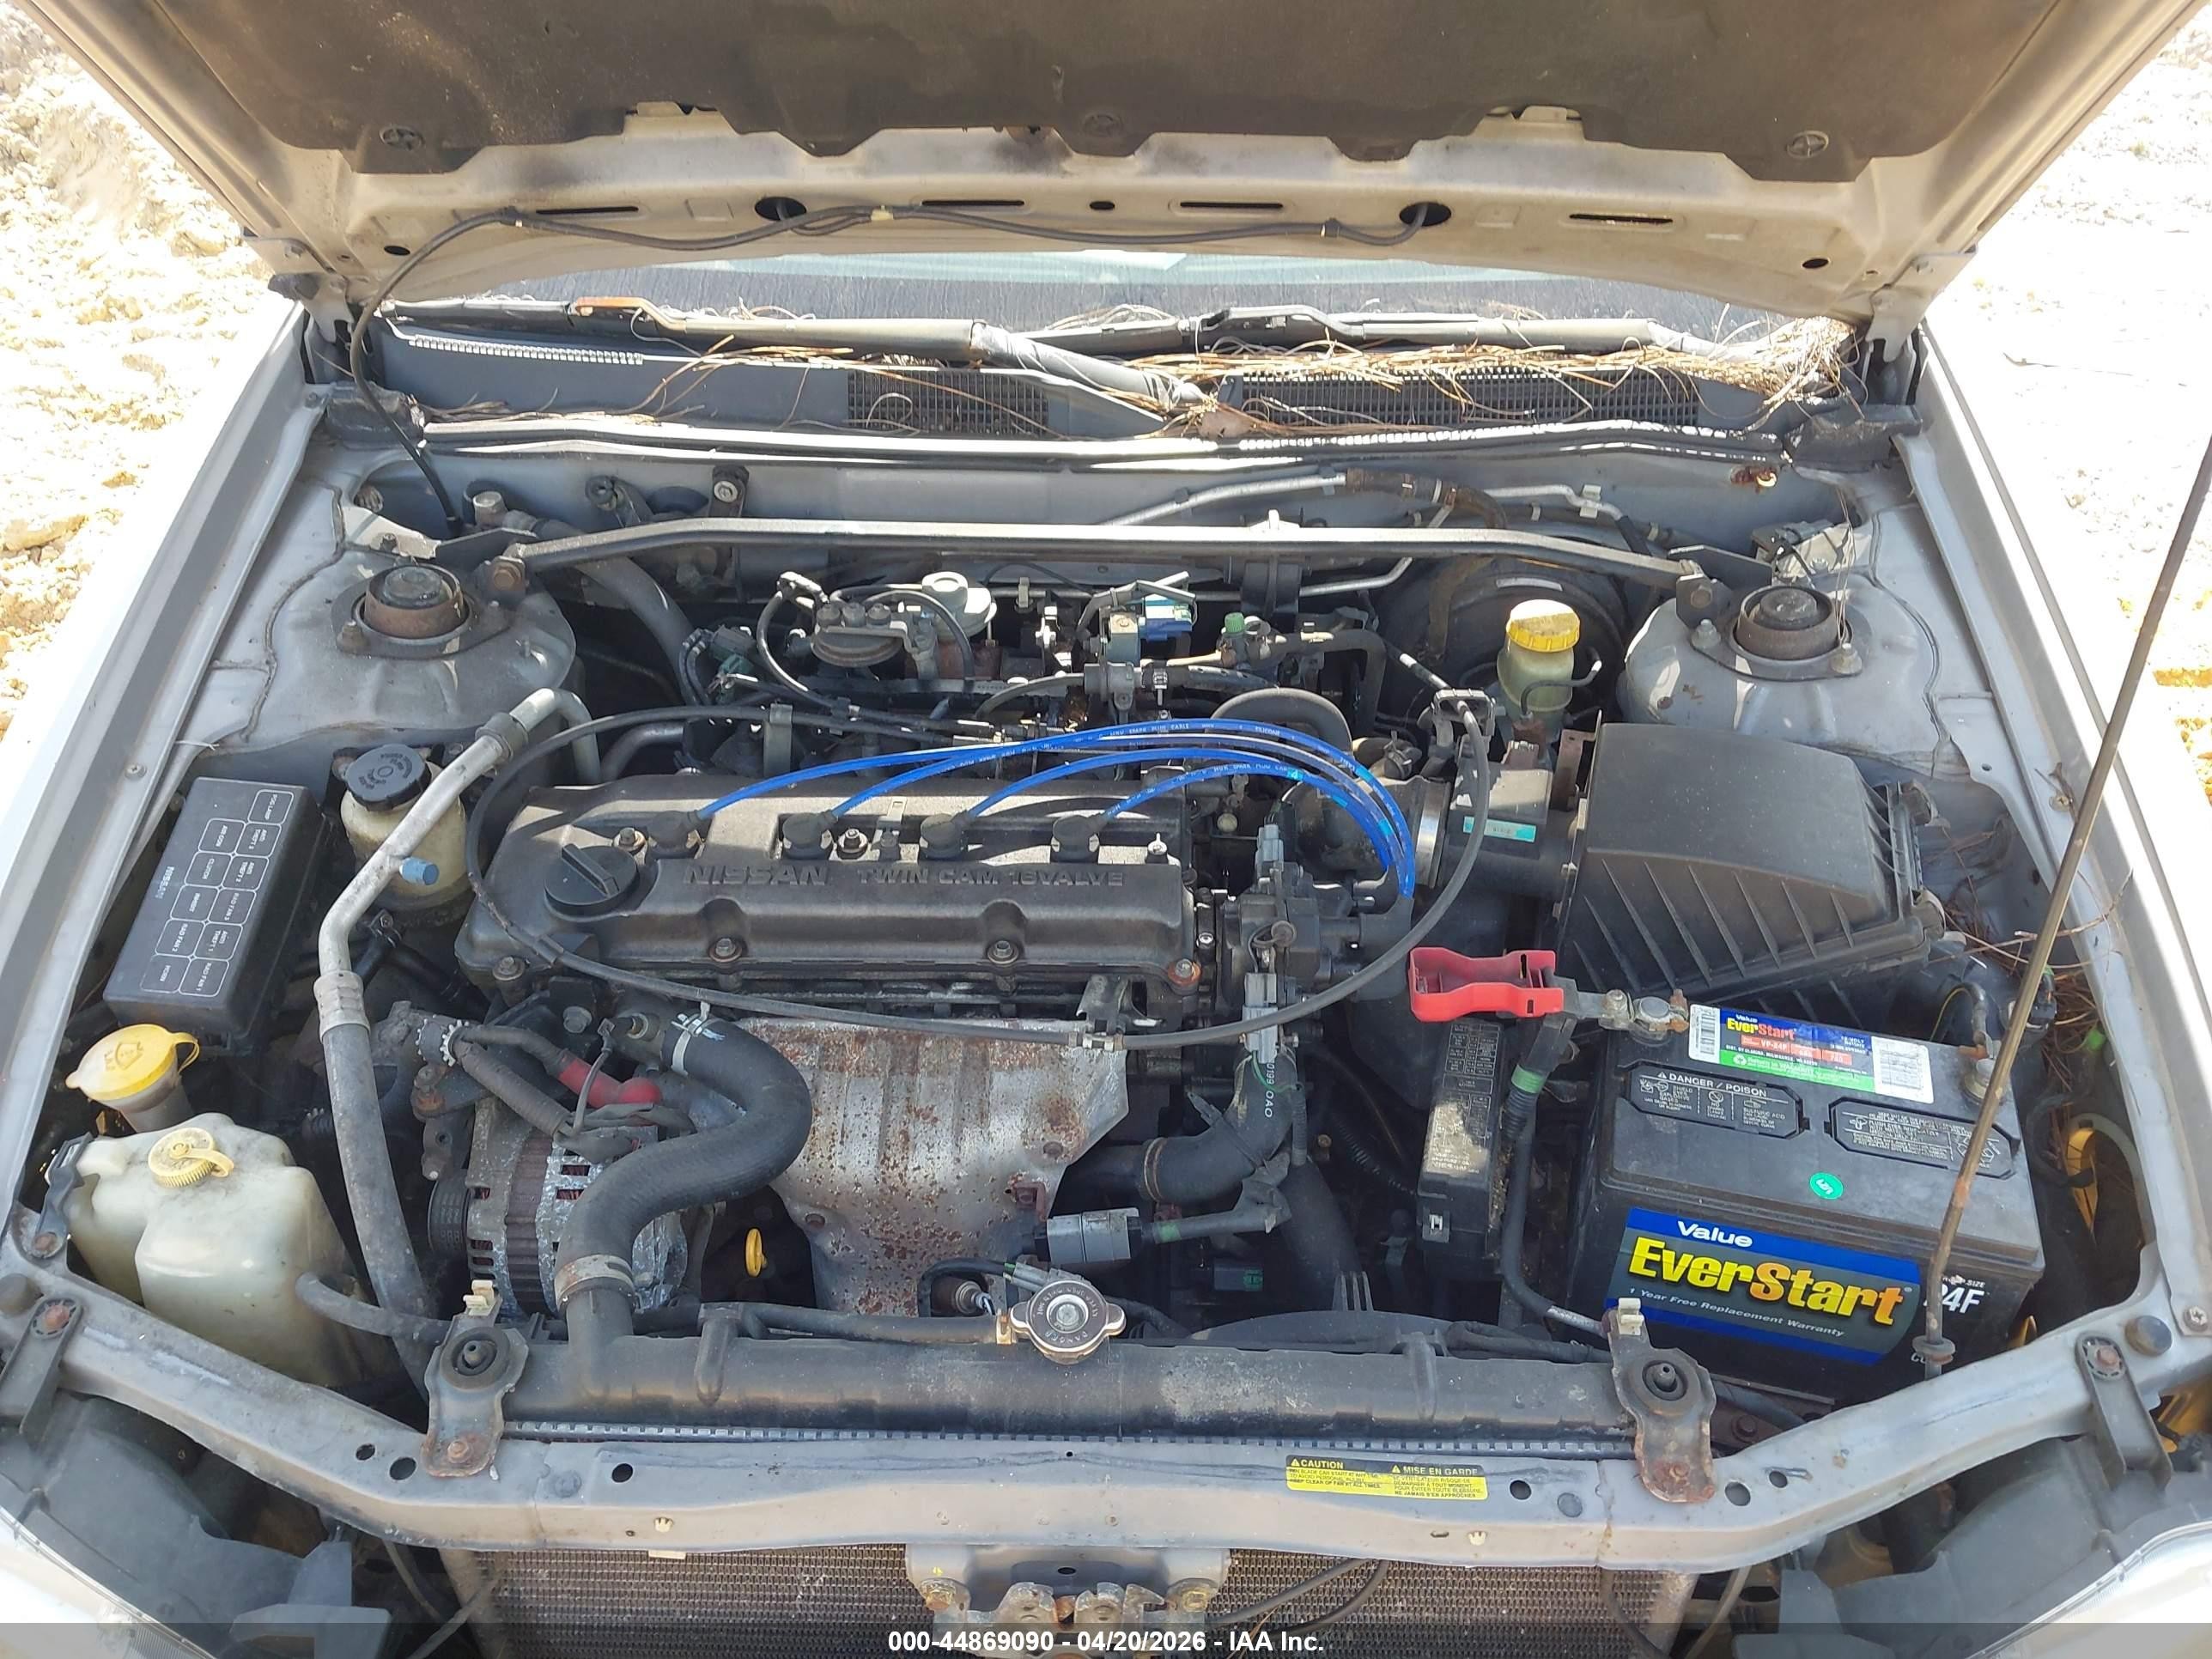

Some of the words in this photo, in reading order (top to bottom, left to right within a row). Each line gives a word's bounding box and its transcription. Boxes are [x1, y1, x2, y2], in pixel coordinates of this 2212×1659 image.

[155, 866, 174, 899] NISSAN
[684, 866, 827, 885] NISSAN
[860, 867, 930, 884] TWIN
[939, 867, 999, 885] CAM
[1727, 1017, 1795, 1041] EverStart
[1735, 1013, 1758, 1023] Value
[1669, 1073, 1713, 1088] DANGER
[1725, 1084, 1767, 1097] POISON
[1677, 1221, 1753, 1248] Value
[1628, 1237, 1904, 1326] EverStart
[1640, 1289, 1668, 1303] Year
[1669, 1295, 1698, 1307] Free
[1700, 1301, 1784, 1325] Replacement
[1786, 1316, 1846, 1338] Warranty
[1045, 1331, 1089, 1344] DANGER
[1300, 1459, 1344, 1469] CAUTION
[1403, 1466, 1425, 1474] MISE
[1429, 1467, 1442, 1475] EN
[1444, 1468, 1477, 1476] GARDE
